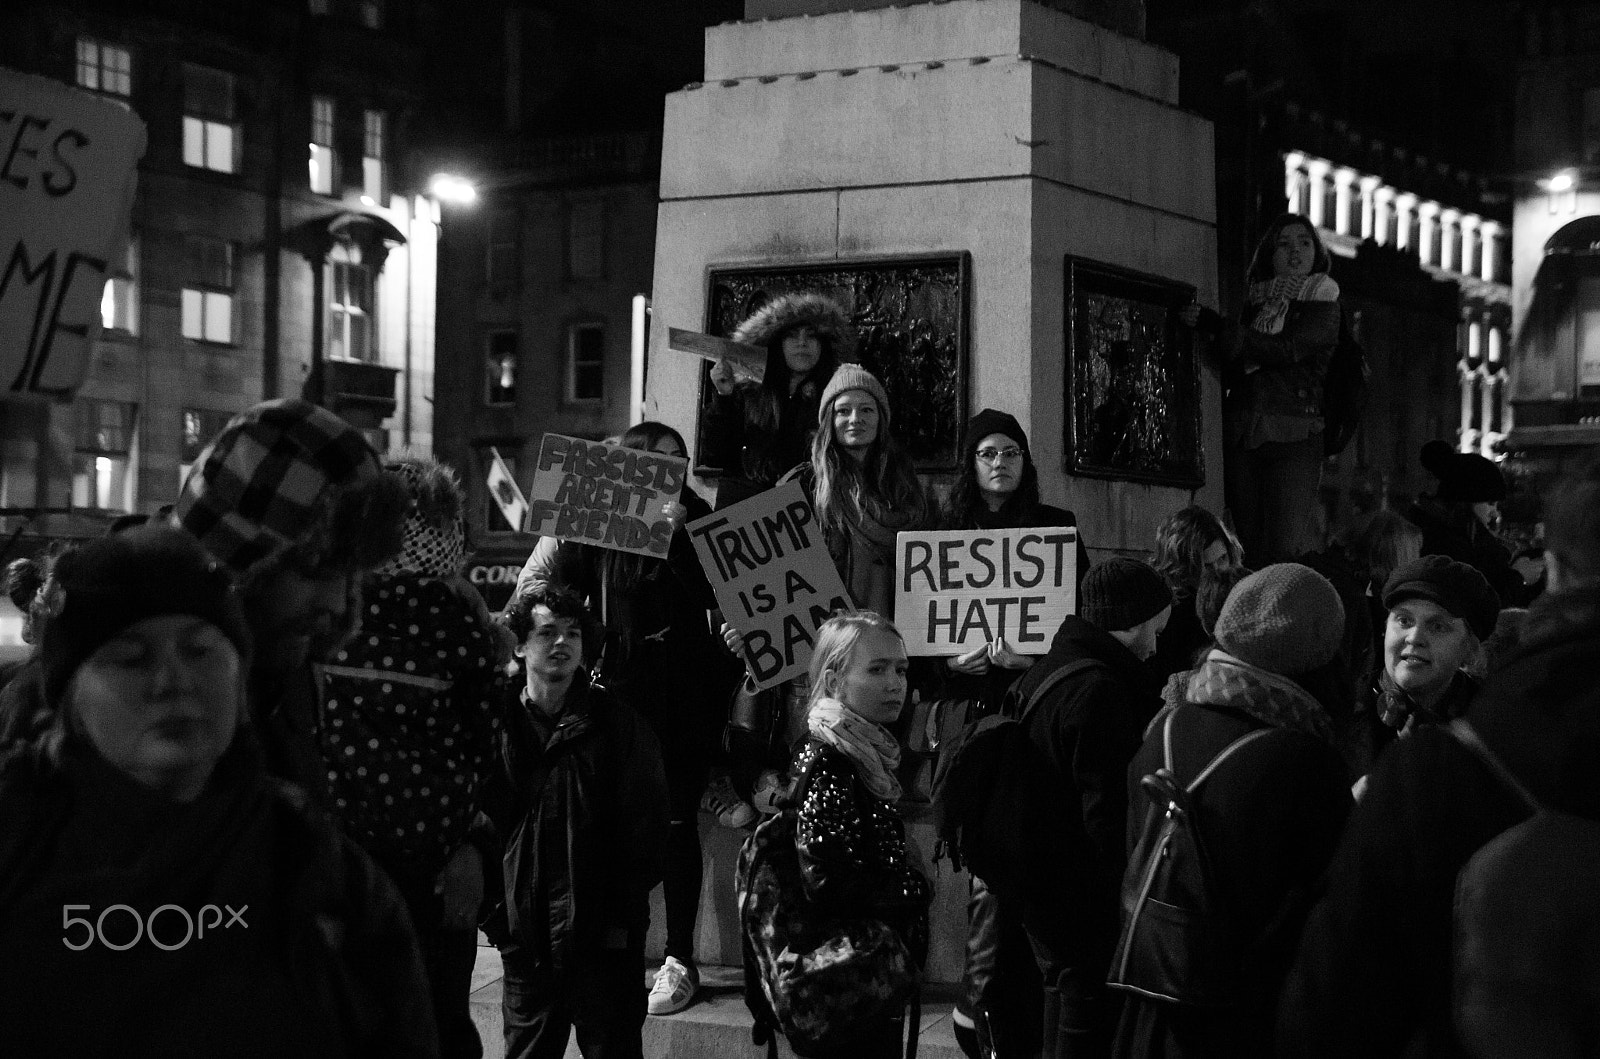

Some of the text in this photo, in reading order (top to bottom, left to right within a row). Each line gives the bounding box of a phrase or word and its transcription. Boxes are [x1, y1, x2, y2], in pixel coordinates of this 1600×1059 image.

[539, 435, 684, 494] FASCISTS
[530, 500, 673, 553] FRIENDS
[692, 500, 811, 582] TRUMP
[904, 534, 1076, 592] RESIST
[738, 570, 817, 617] IS A
[927, 596, 1046, 644] HATE
